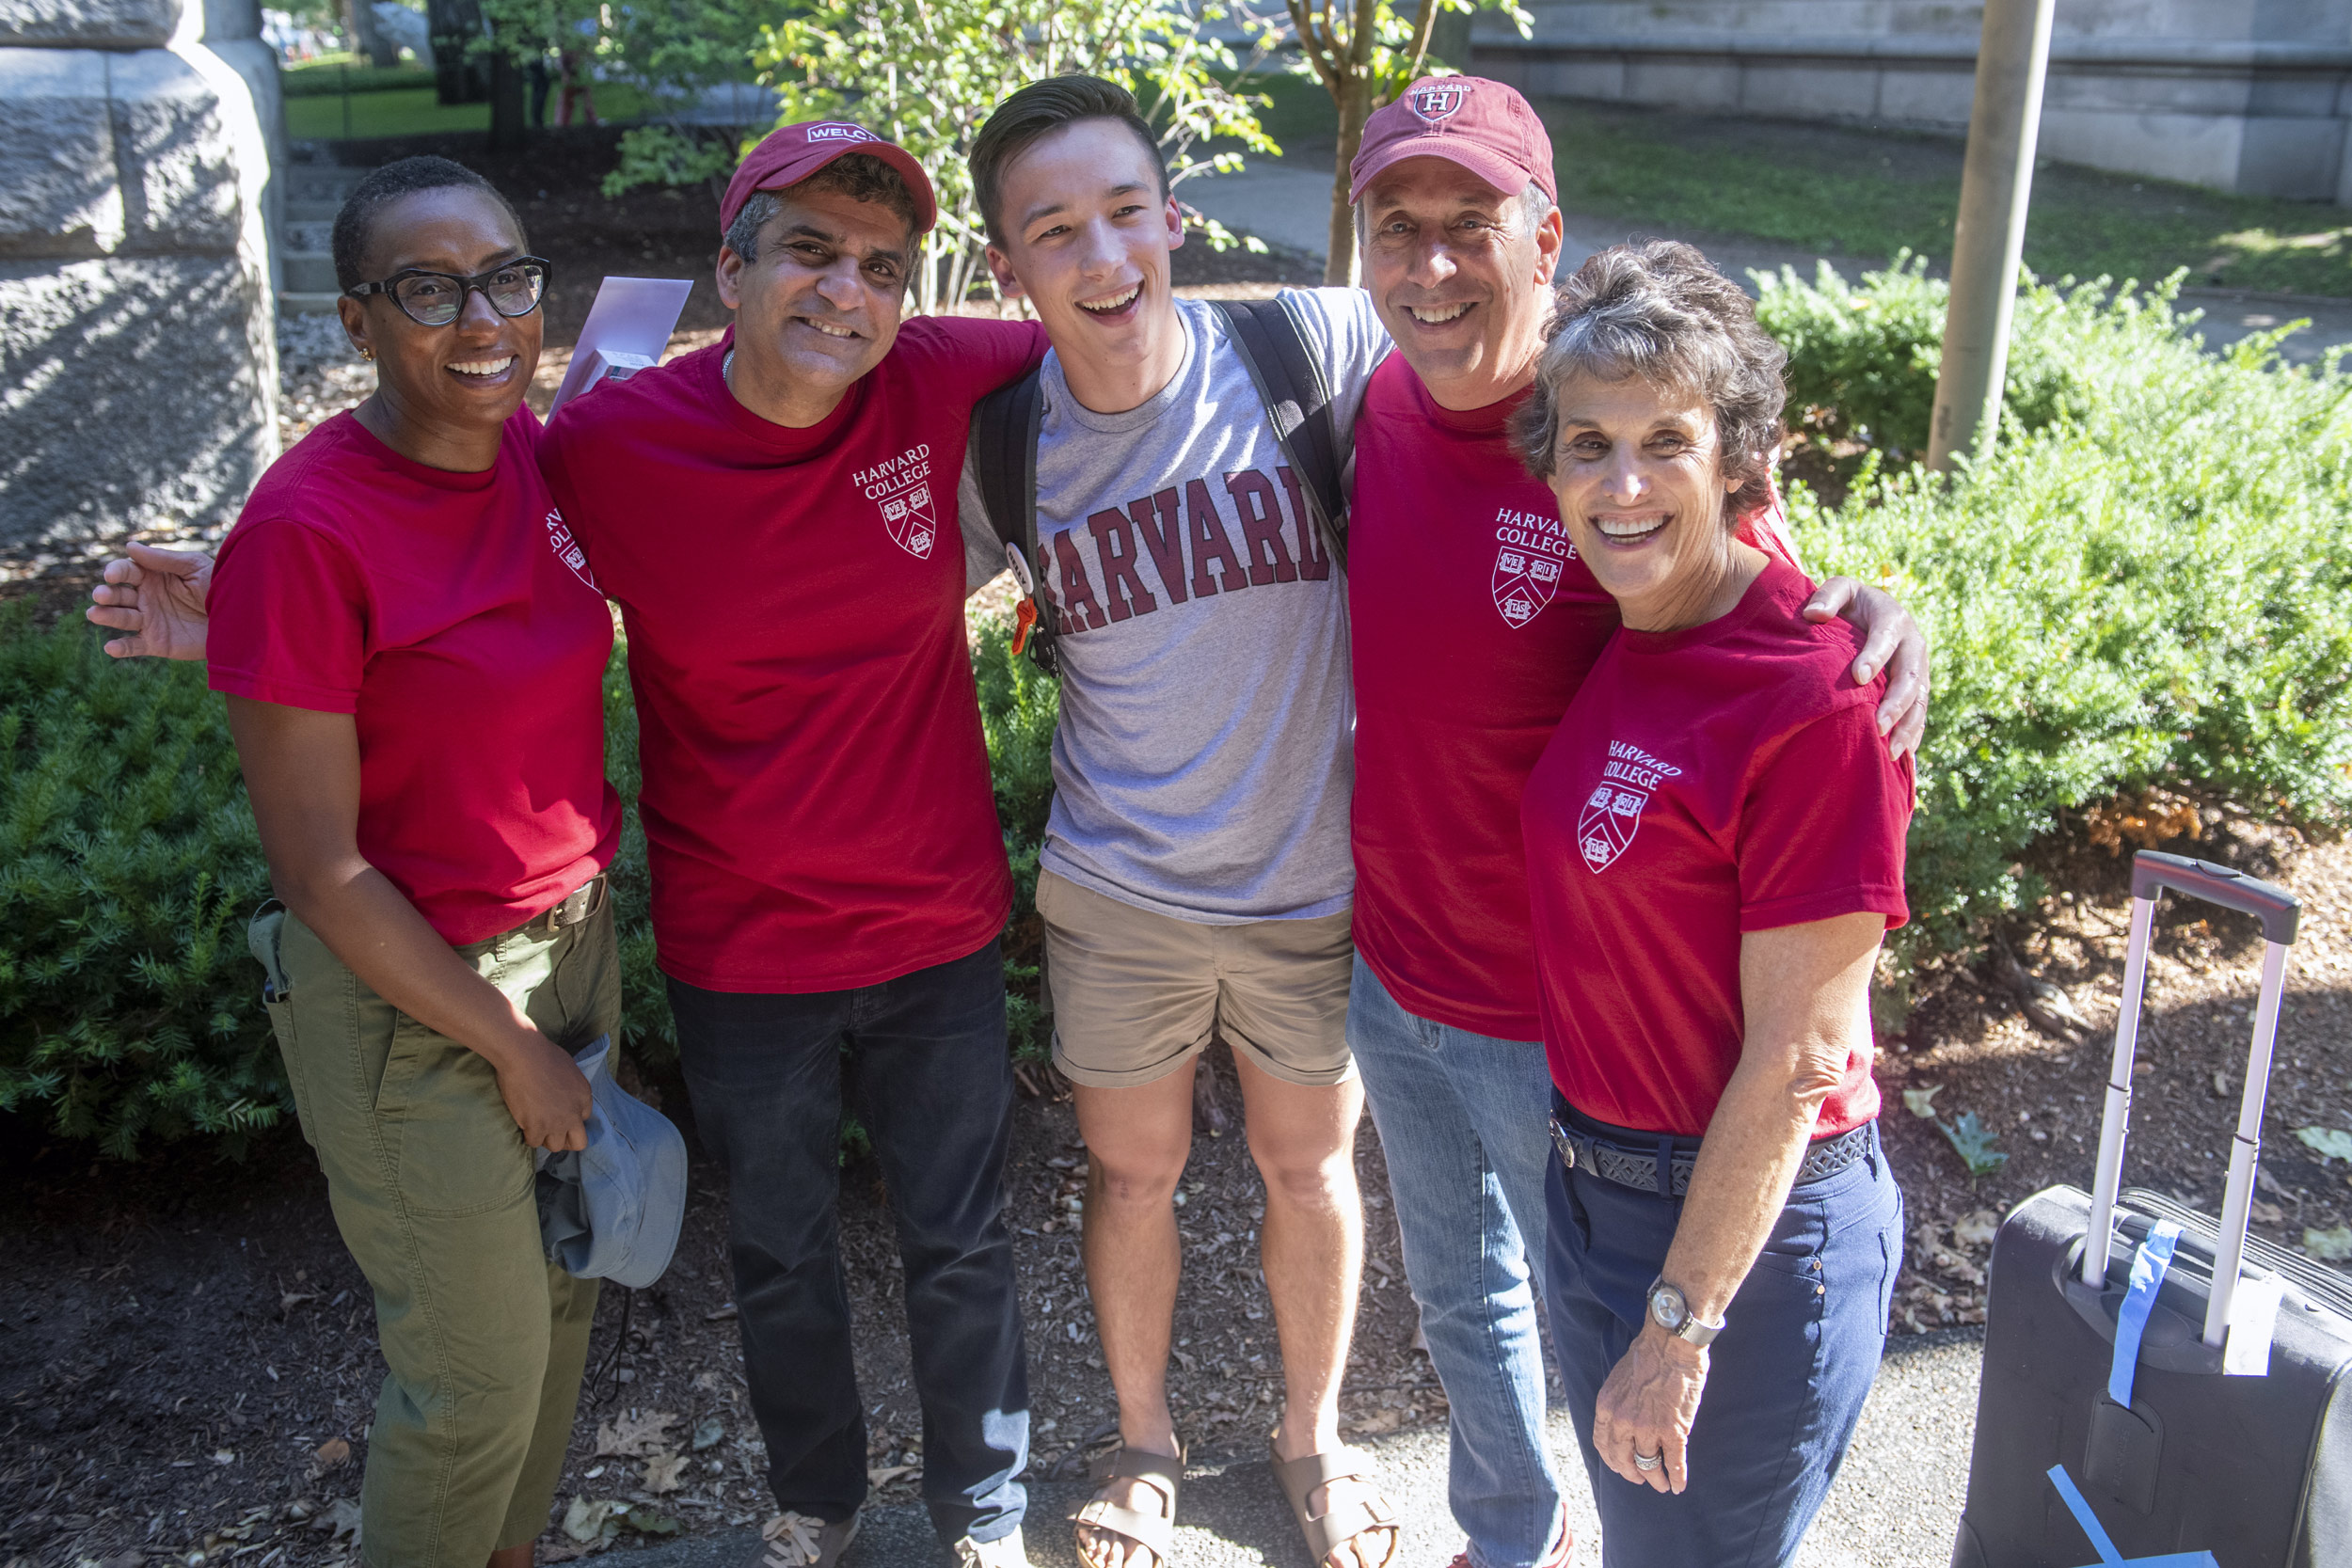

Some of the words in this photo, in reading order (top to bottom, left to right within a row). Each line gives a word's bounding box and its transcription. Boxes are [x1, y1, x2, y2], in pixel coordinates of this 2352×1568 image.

[1409, 84, 1471, 95] HARVARD
[1422, 92, 1450, 112] H
[811, 128, 874, 141] WELC
[852, 444, 930, 487] HARVARD
[865, 461, 931, 499] COLLEGE
[1496, 527, 1578, 560] COLLEGE
[1608, 740, 1682, 776] HARVARD
[1603, 760, 1662, 791] COLLEGE
